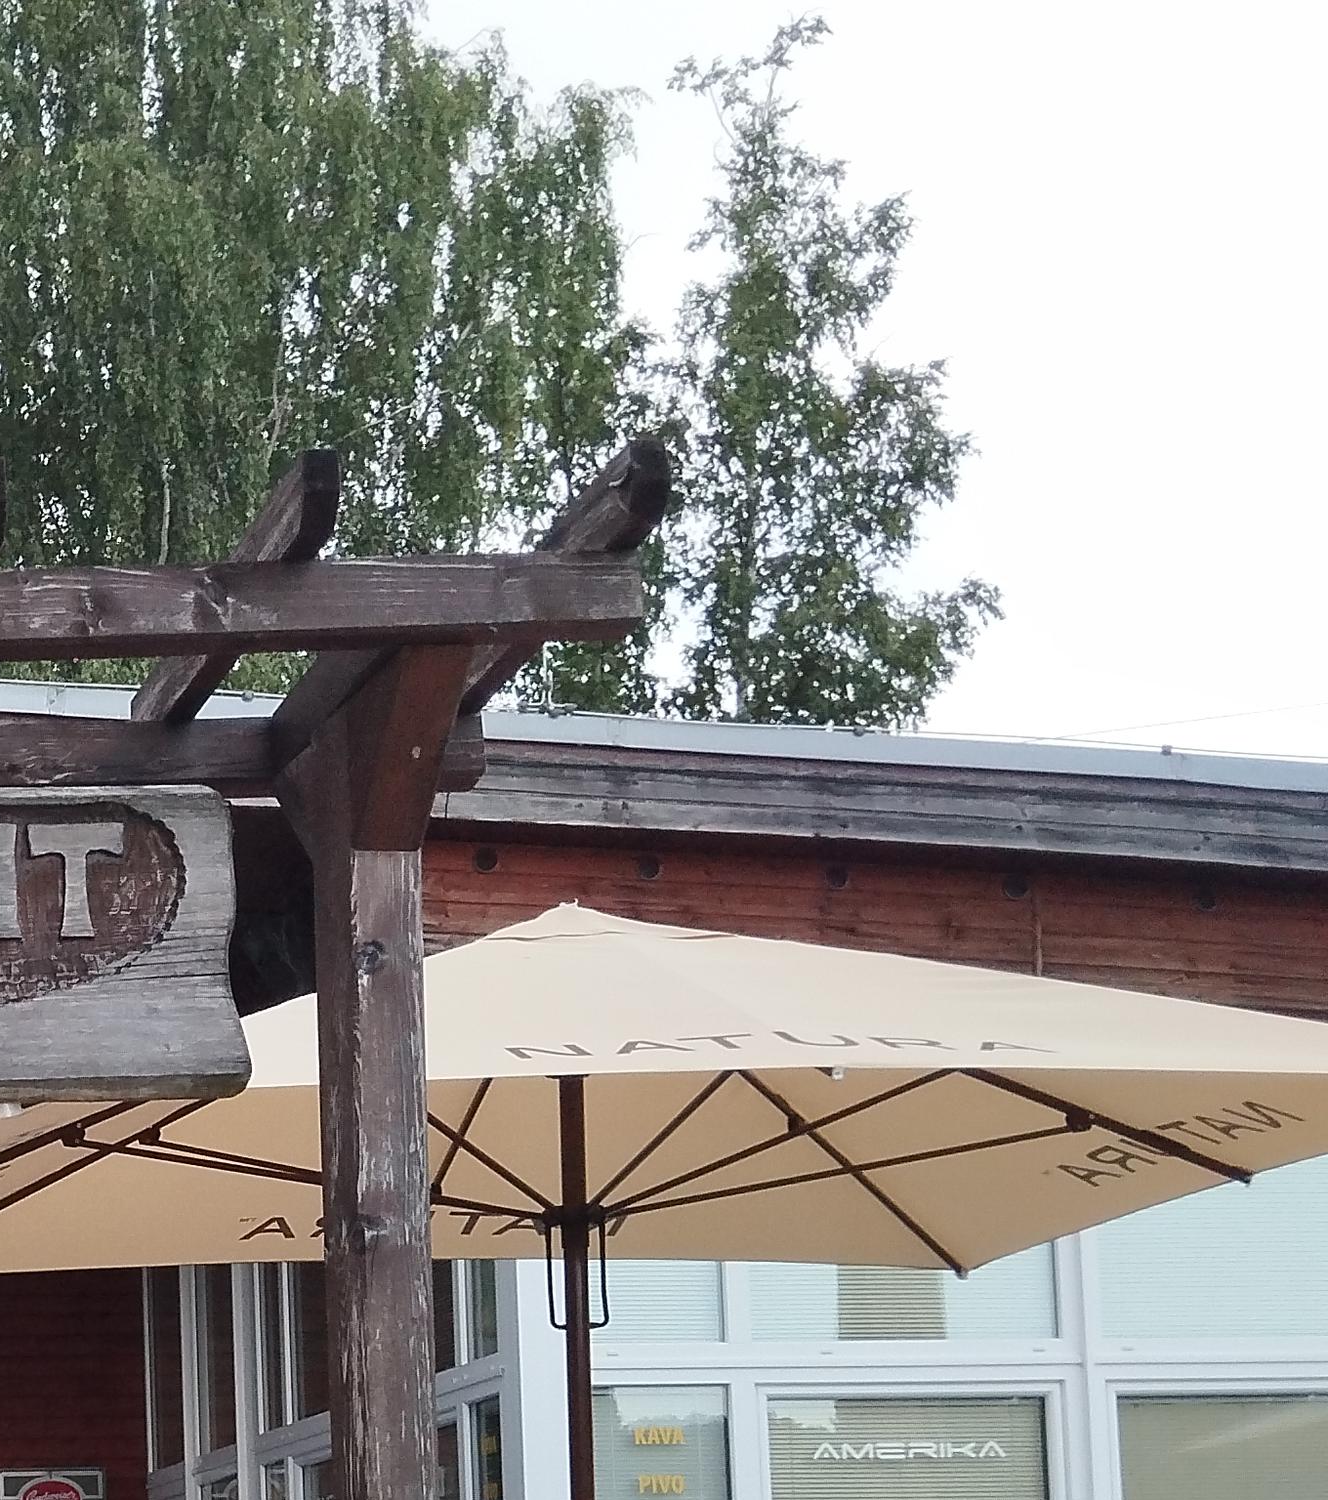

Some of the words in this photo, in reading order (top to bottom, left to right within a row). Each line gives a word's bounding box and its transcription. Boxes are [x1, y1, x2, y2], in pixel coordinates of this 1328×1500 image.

[503, 1031, 1059, 1060] NATURA
[813, 1440, 1006, 1459] AMERIKA
[638, 1474, 686, 1494] PIVO
